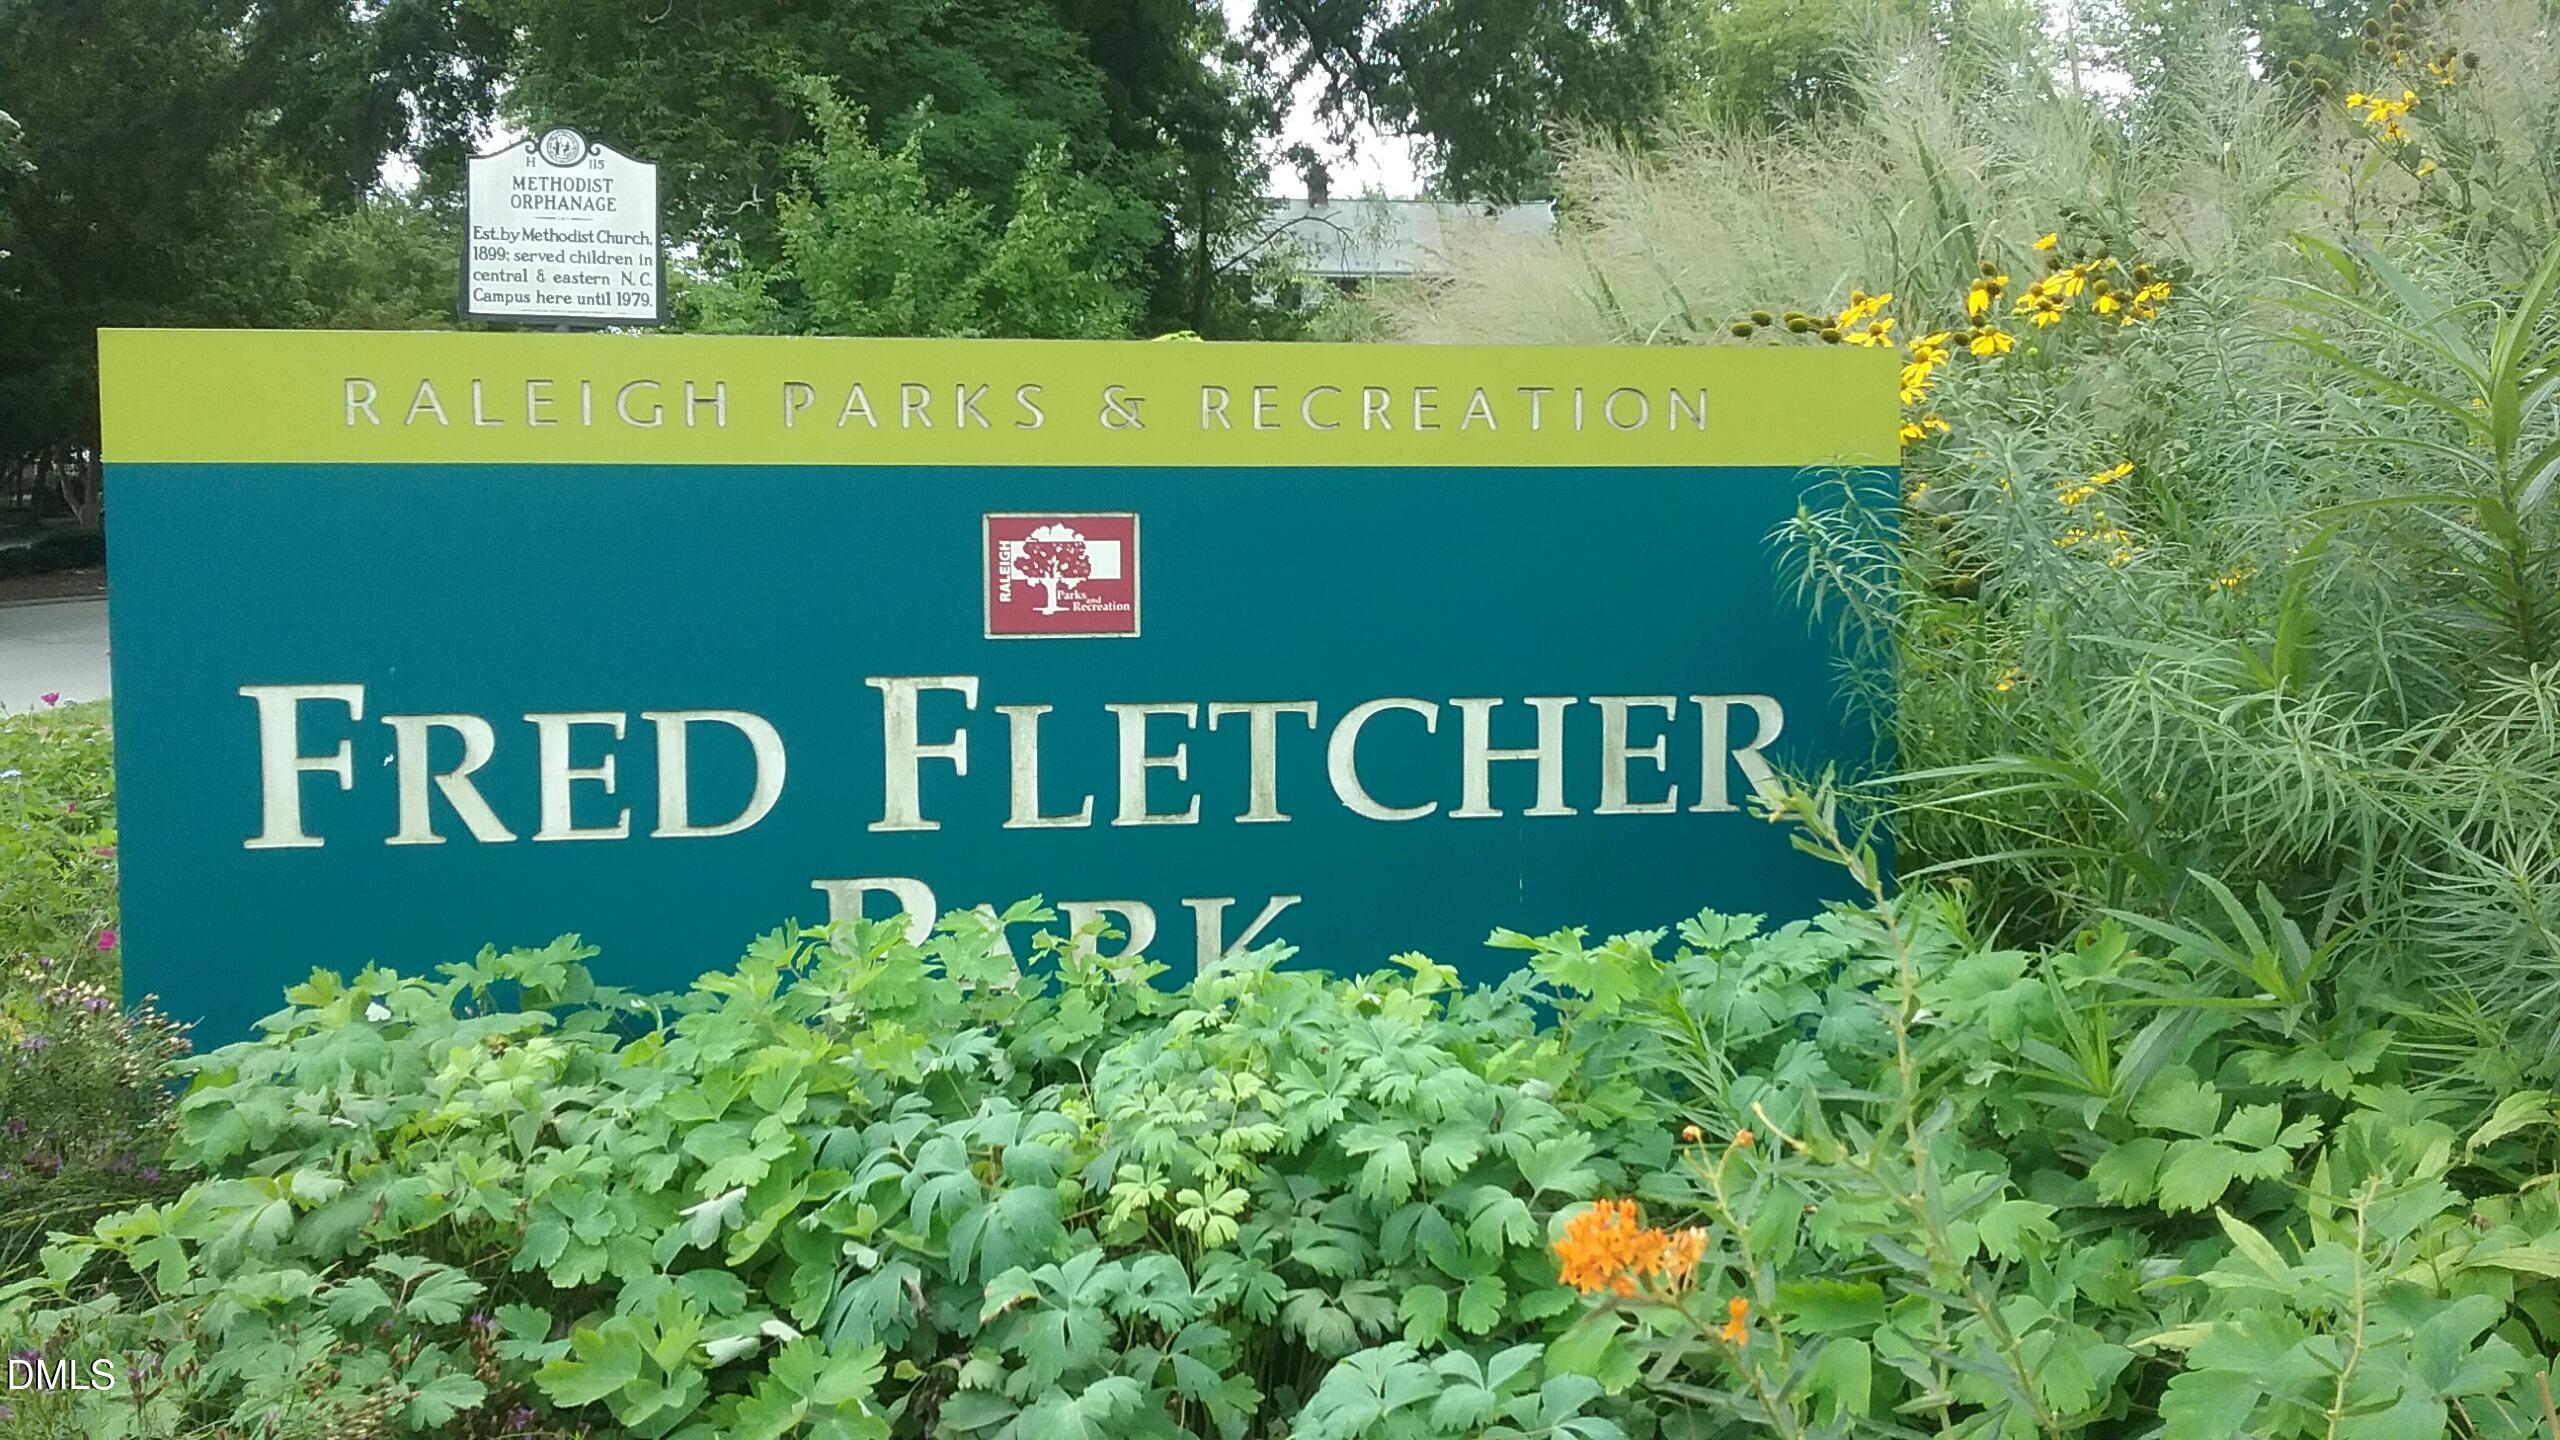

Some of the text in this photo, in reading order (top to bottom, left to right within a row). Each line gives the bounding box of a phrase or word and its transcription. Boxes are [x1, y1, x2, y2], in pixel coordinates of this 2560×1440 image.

[526, 157, 605, 169] H 115
[512, 176, 614, 193] METHODIST
[510, 194, 617, 212] ORPHANAGE
[500, 226, 520, 244] by
[521, 227, 594, 243] Methodist
[513, 250, 565, 263] served
[569, 250, 633, 266] children
[639, 253, 653, 266] in
[472, 269, 528, 283] central
[536, 270, 545, 283] &
[553, 272, 610, 285] eastern
[472, 288, 653, 308] Campus here until 1979.
[344, 378, 1708, 433] RALEIGH PARKS & RECREATION
[999, 541, 1012, 602] RALEIGH
[1057, 590, 1087, 601] Parks
[1087, 596, 1102, 604] and
[1073, 601, 1131, 612] Recreation
[239, 675, 1792, 848] FRED FLETCHER
